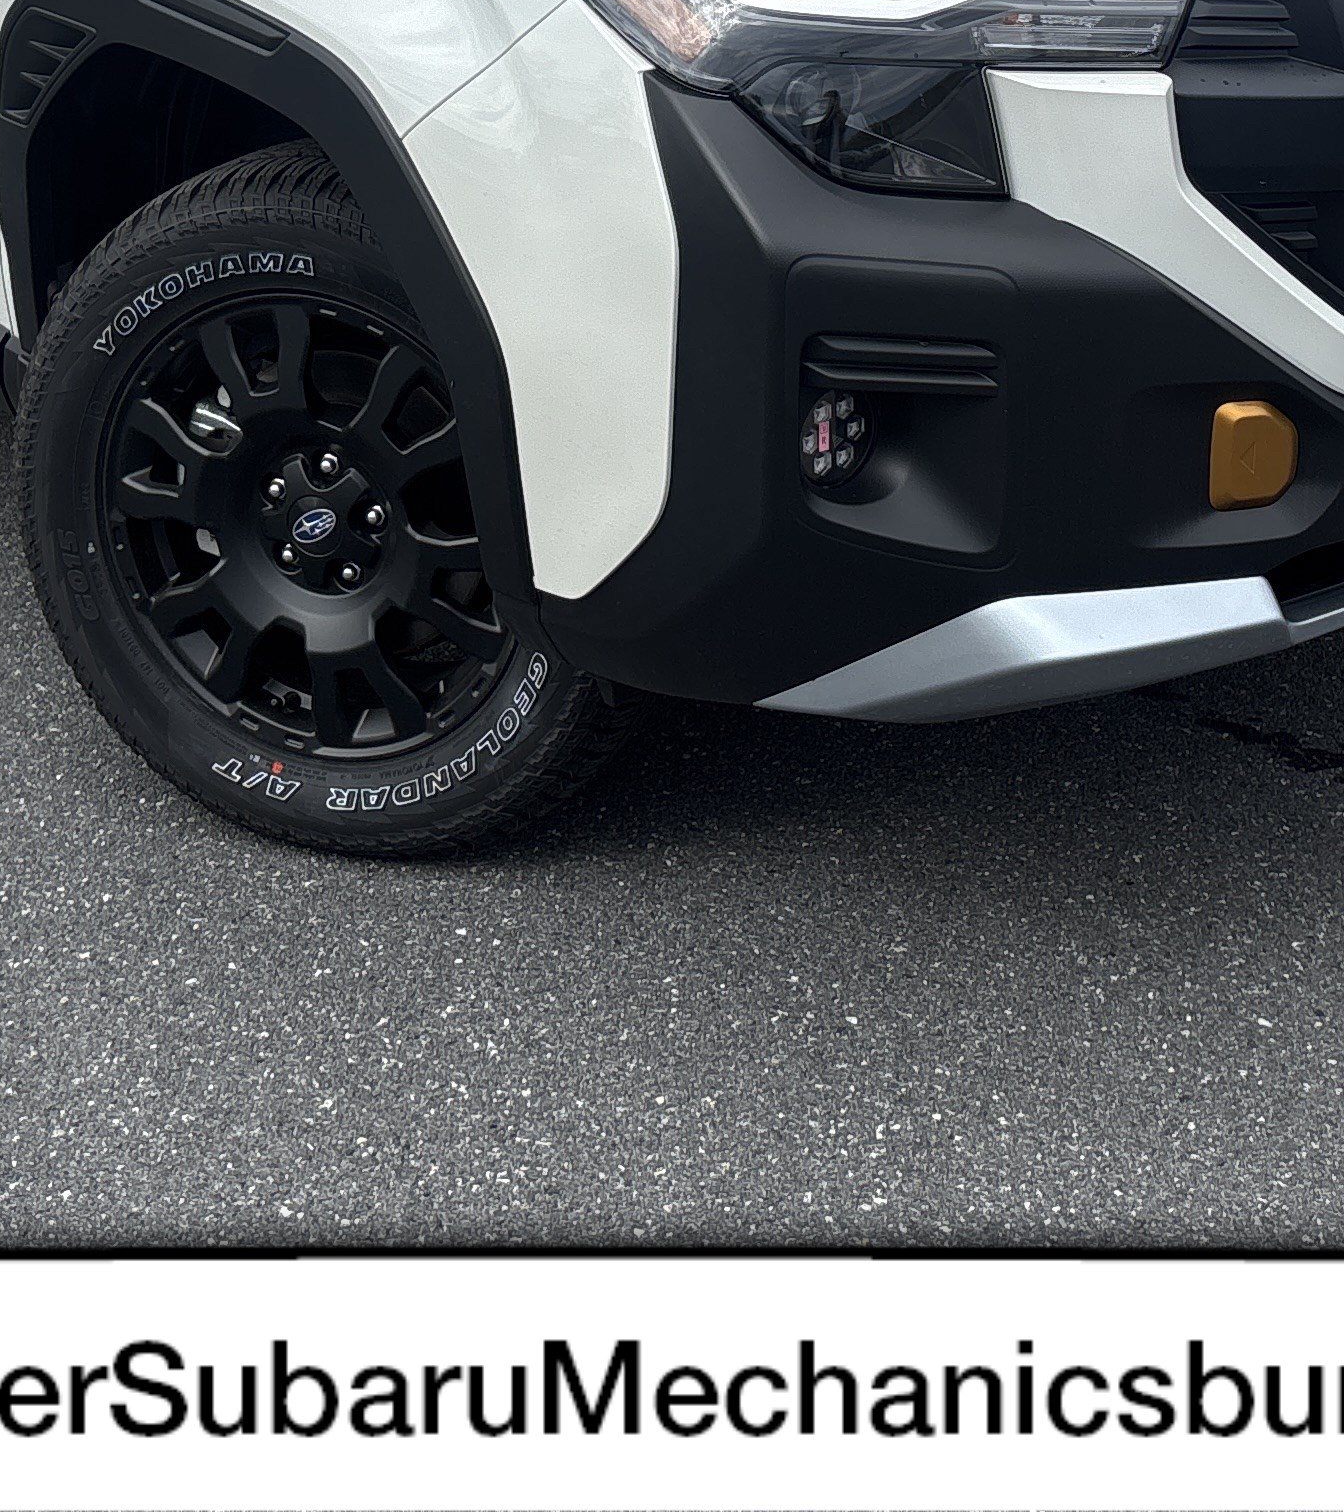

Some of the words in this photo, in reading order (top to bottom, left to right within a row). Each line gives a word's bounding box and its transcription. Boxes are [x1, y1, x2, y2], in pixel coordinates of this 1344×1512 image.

[92, 252, 314, 357] YOKOHAMA
[211, 757, 303, 802] A/T
[326, 651, 548, 811] GEOLANDAR
